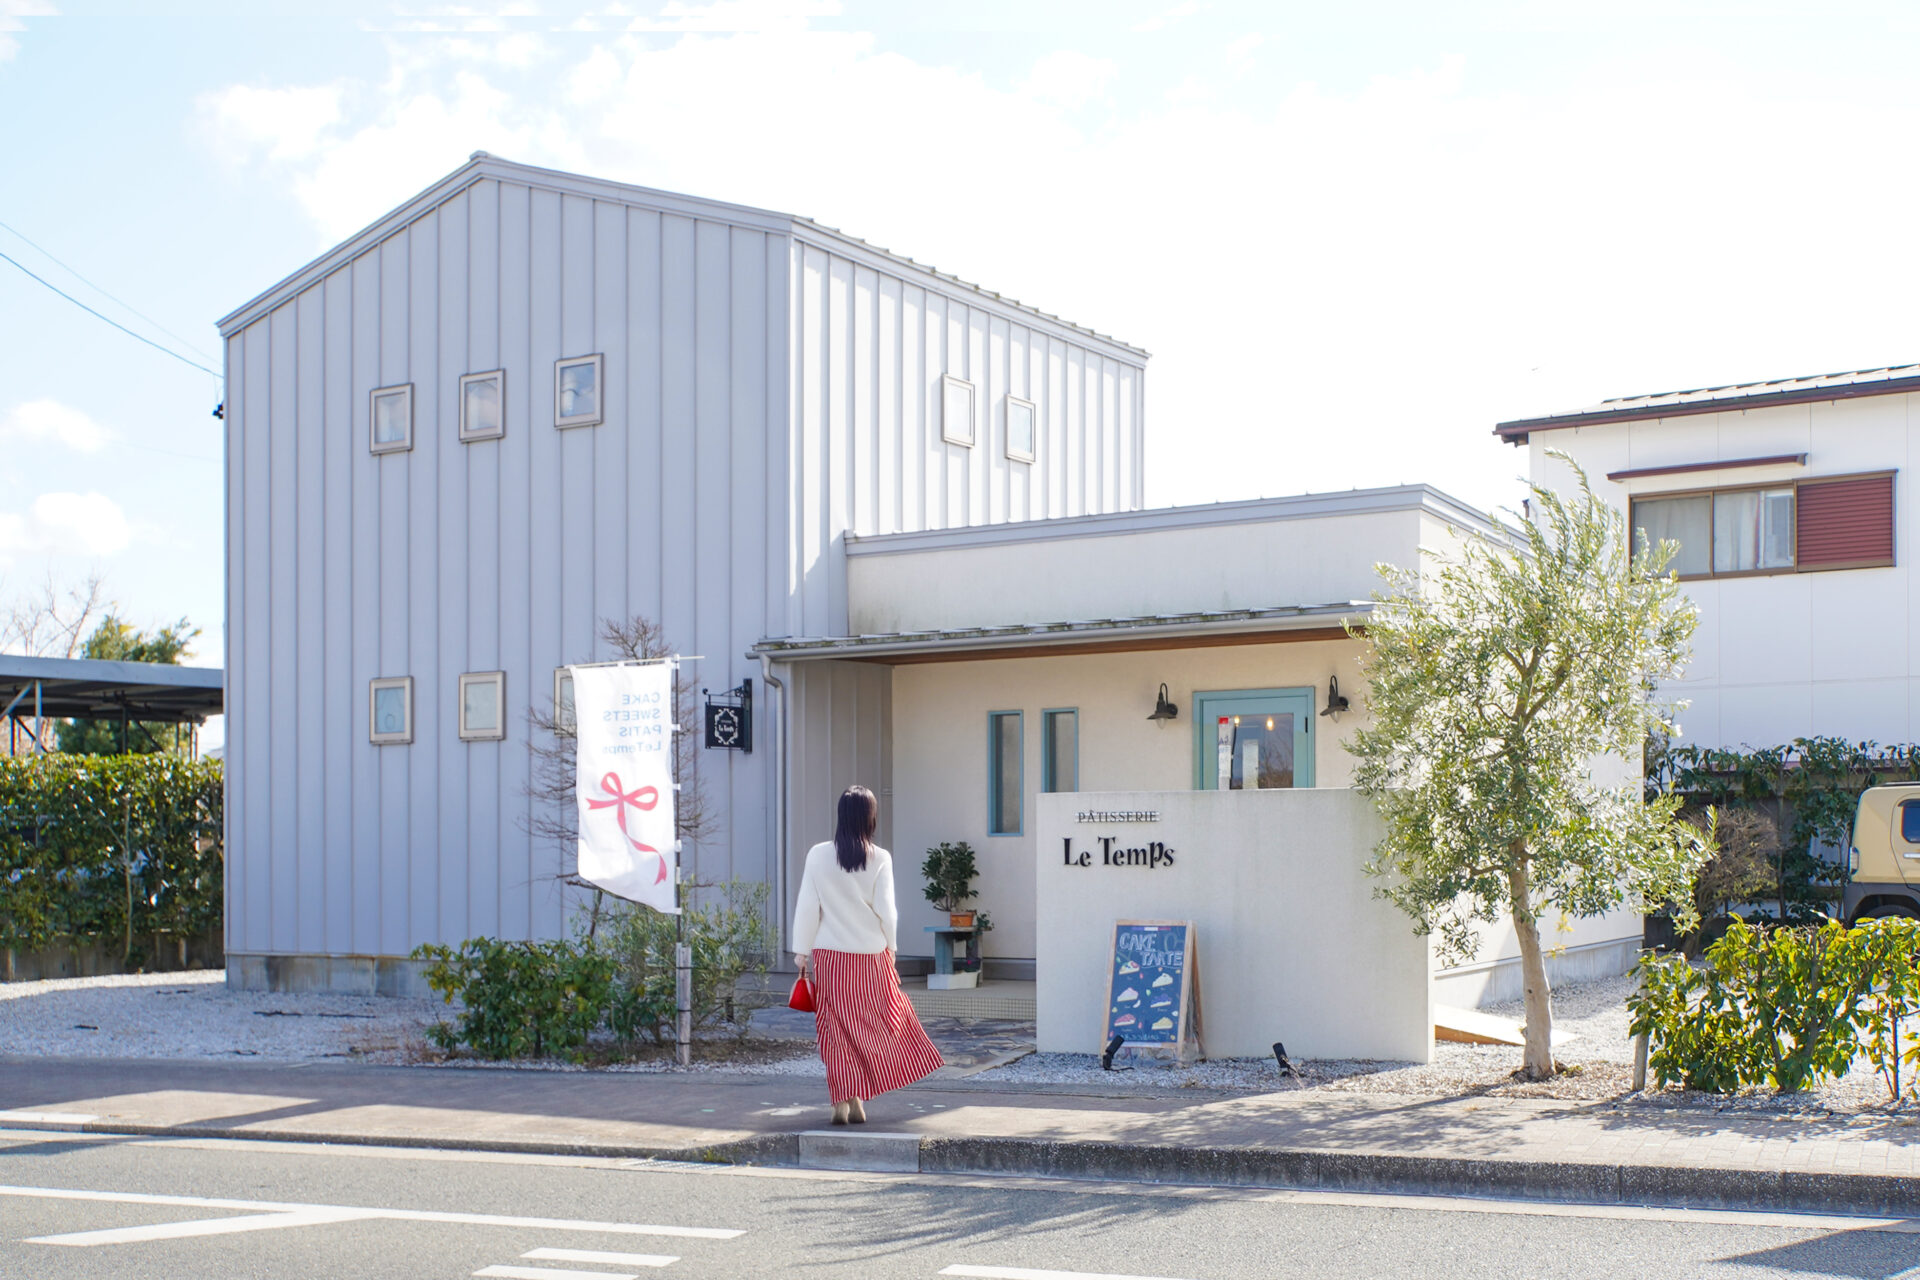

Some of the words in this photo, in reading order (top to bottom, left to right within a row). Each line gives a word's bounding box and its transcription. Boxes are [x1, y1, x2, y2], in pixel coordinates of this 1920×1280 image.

[1077, 810, 1158, 823] PÂTISSERIE
[1062, 837, 1092, 867] Le
[1097, 836, 1175, 869] Temps
[1119, 932, 1158, 952] CAKE
